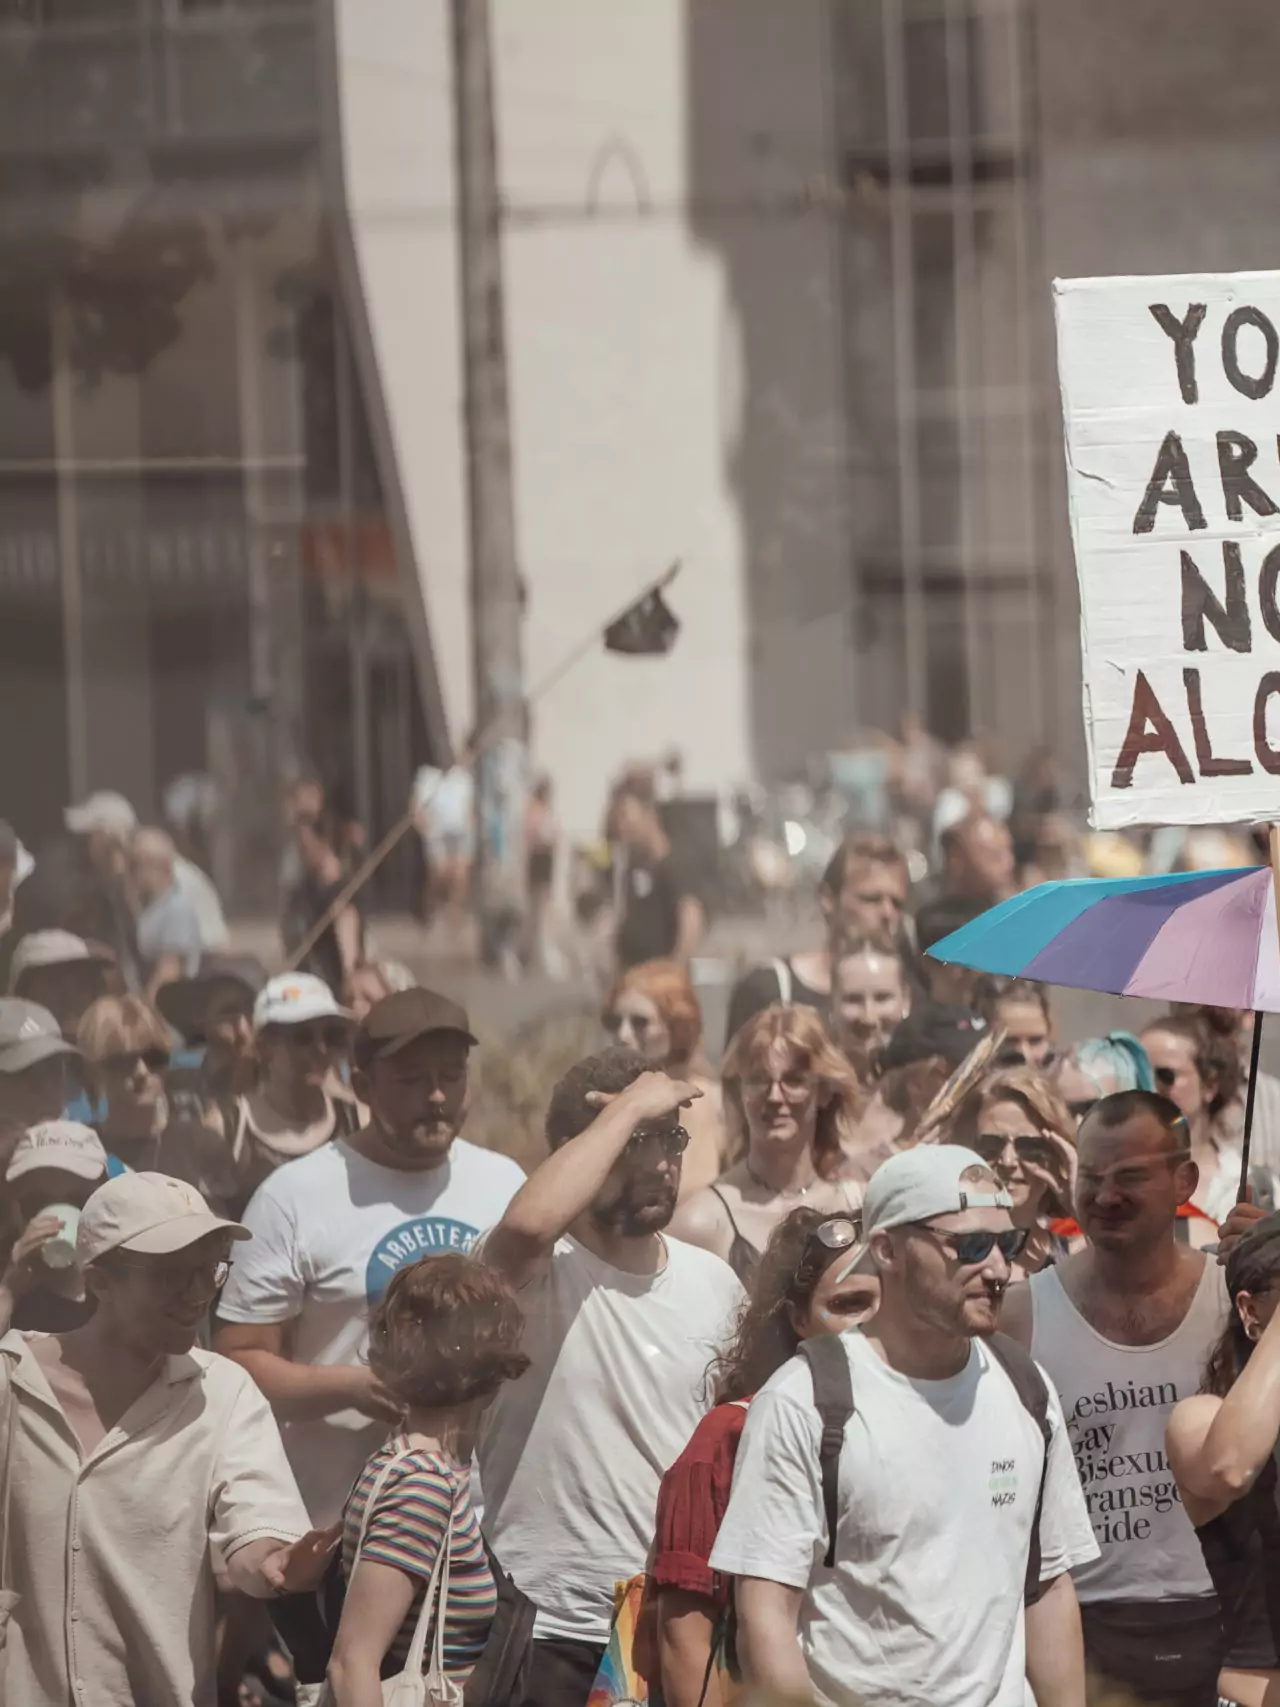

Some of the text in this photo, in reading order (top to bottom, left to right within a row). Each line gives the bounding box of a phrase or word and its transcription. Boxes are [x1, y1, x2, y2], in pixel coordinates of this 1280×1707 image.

[1059, 1381, 1178, 1424] esbian
[991, 1492, 1016, 1508] NAZIS
[1091, 1511, 1152, 1545] ride
